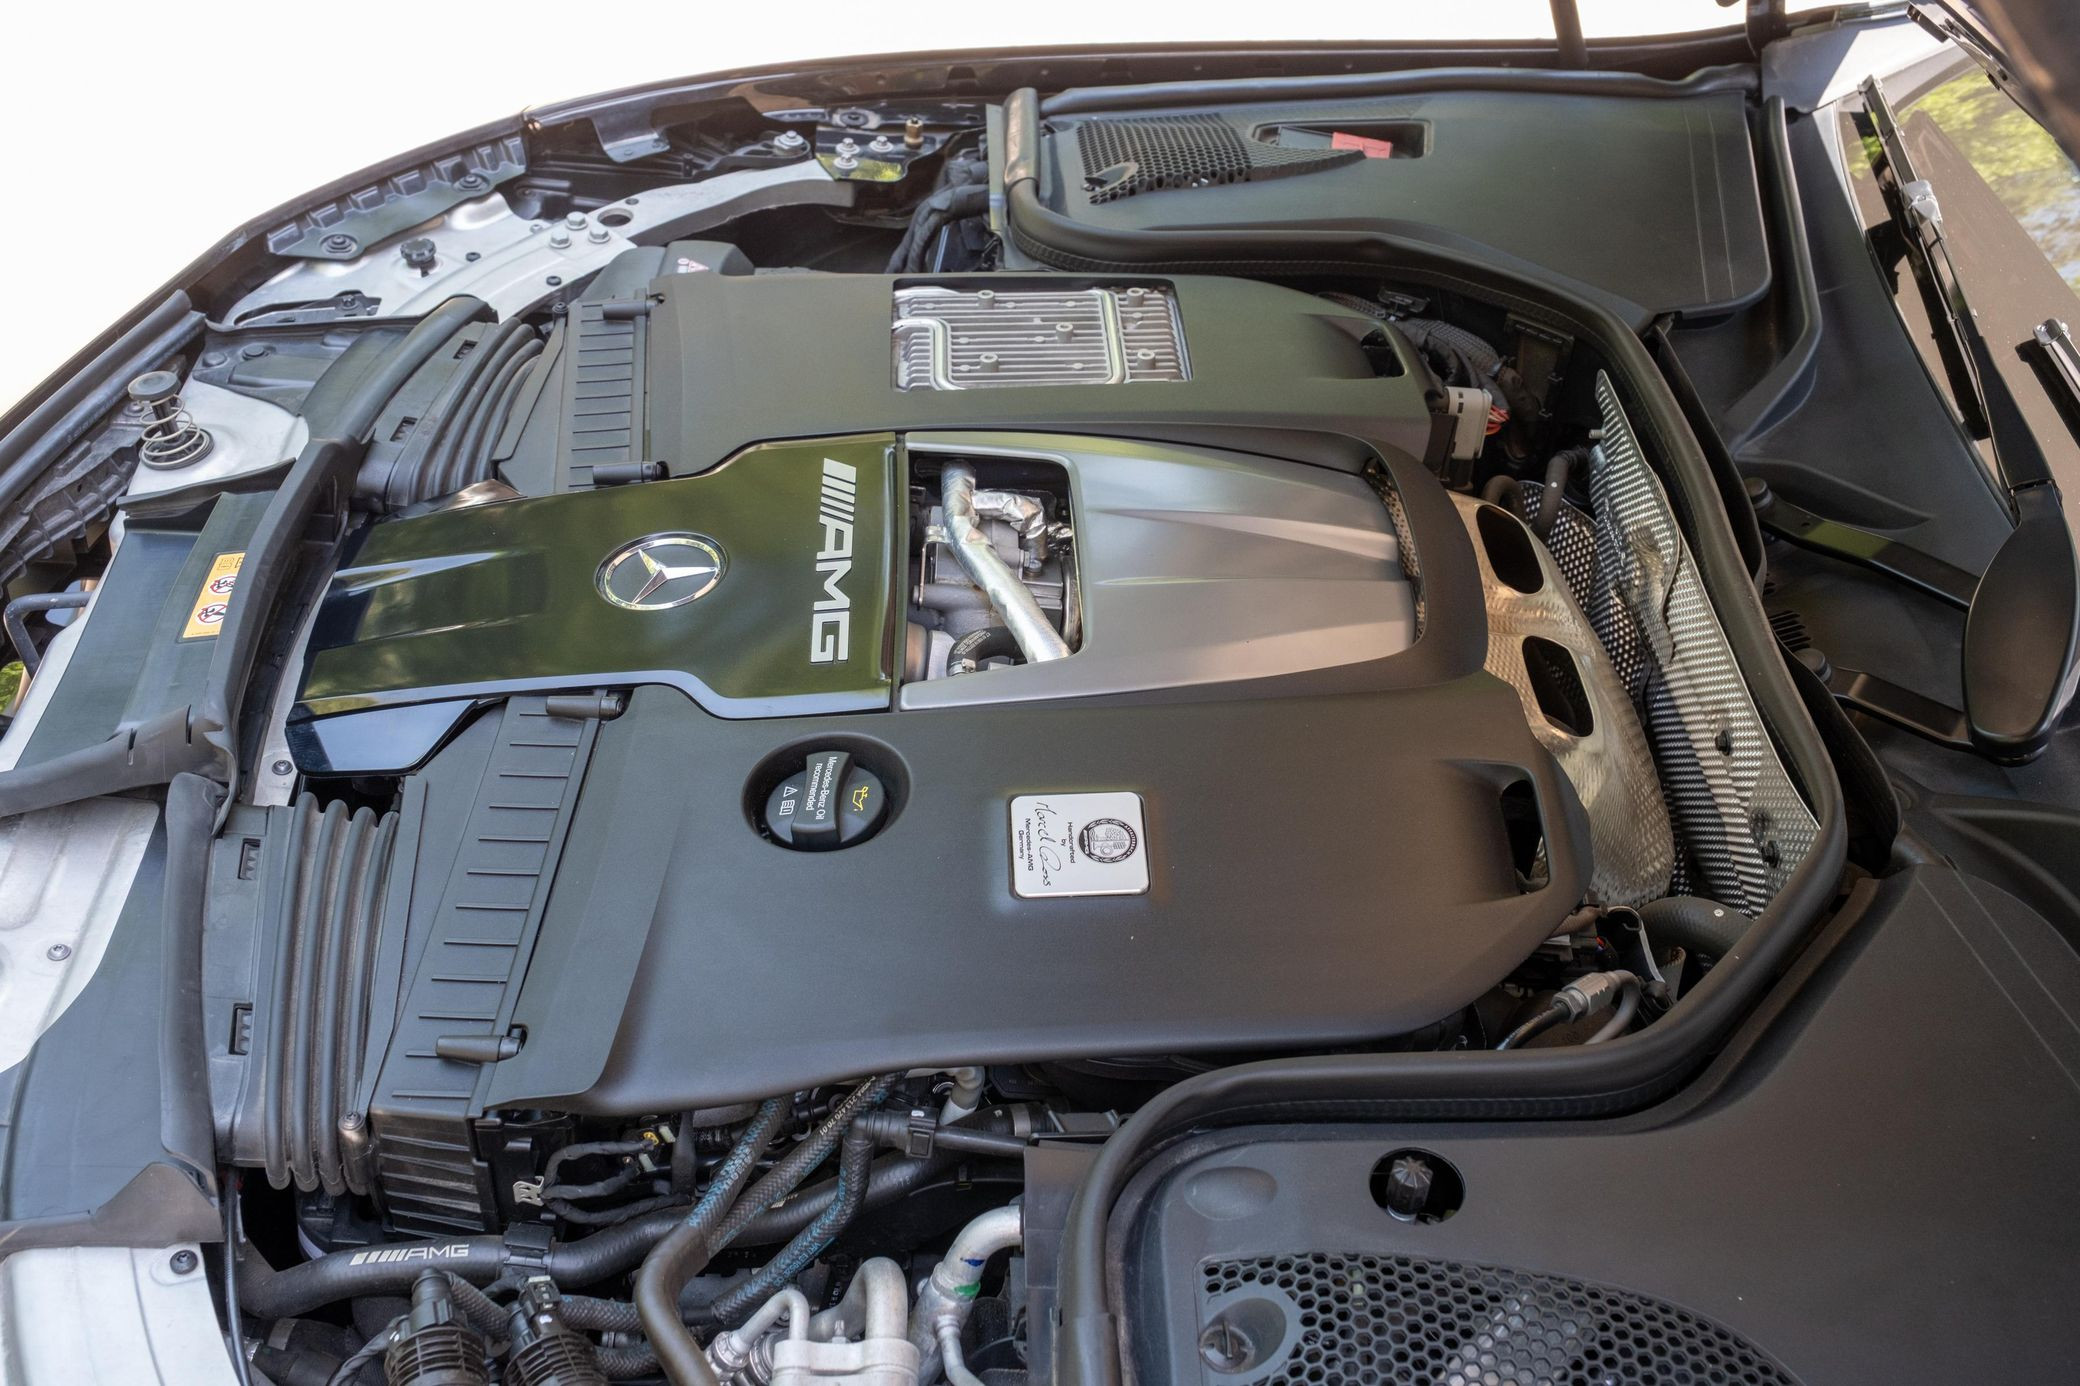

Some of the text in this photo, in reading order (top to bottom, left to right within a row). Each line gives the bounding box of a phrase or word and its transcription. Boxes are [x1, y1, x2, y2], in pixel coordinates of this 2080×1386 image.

[806, 763, 823, 810] recommended
[815, 757, 837, 820] Mercedes-Benz Oil
[1025, 818, 1034, 871] Mercedes-AMG
[1060, 838, 1066, 847] by
[1067, 822, 1076, 863] Handcrafted
